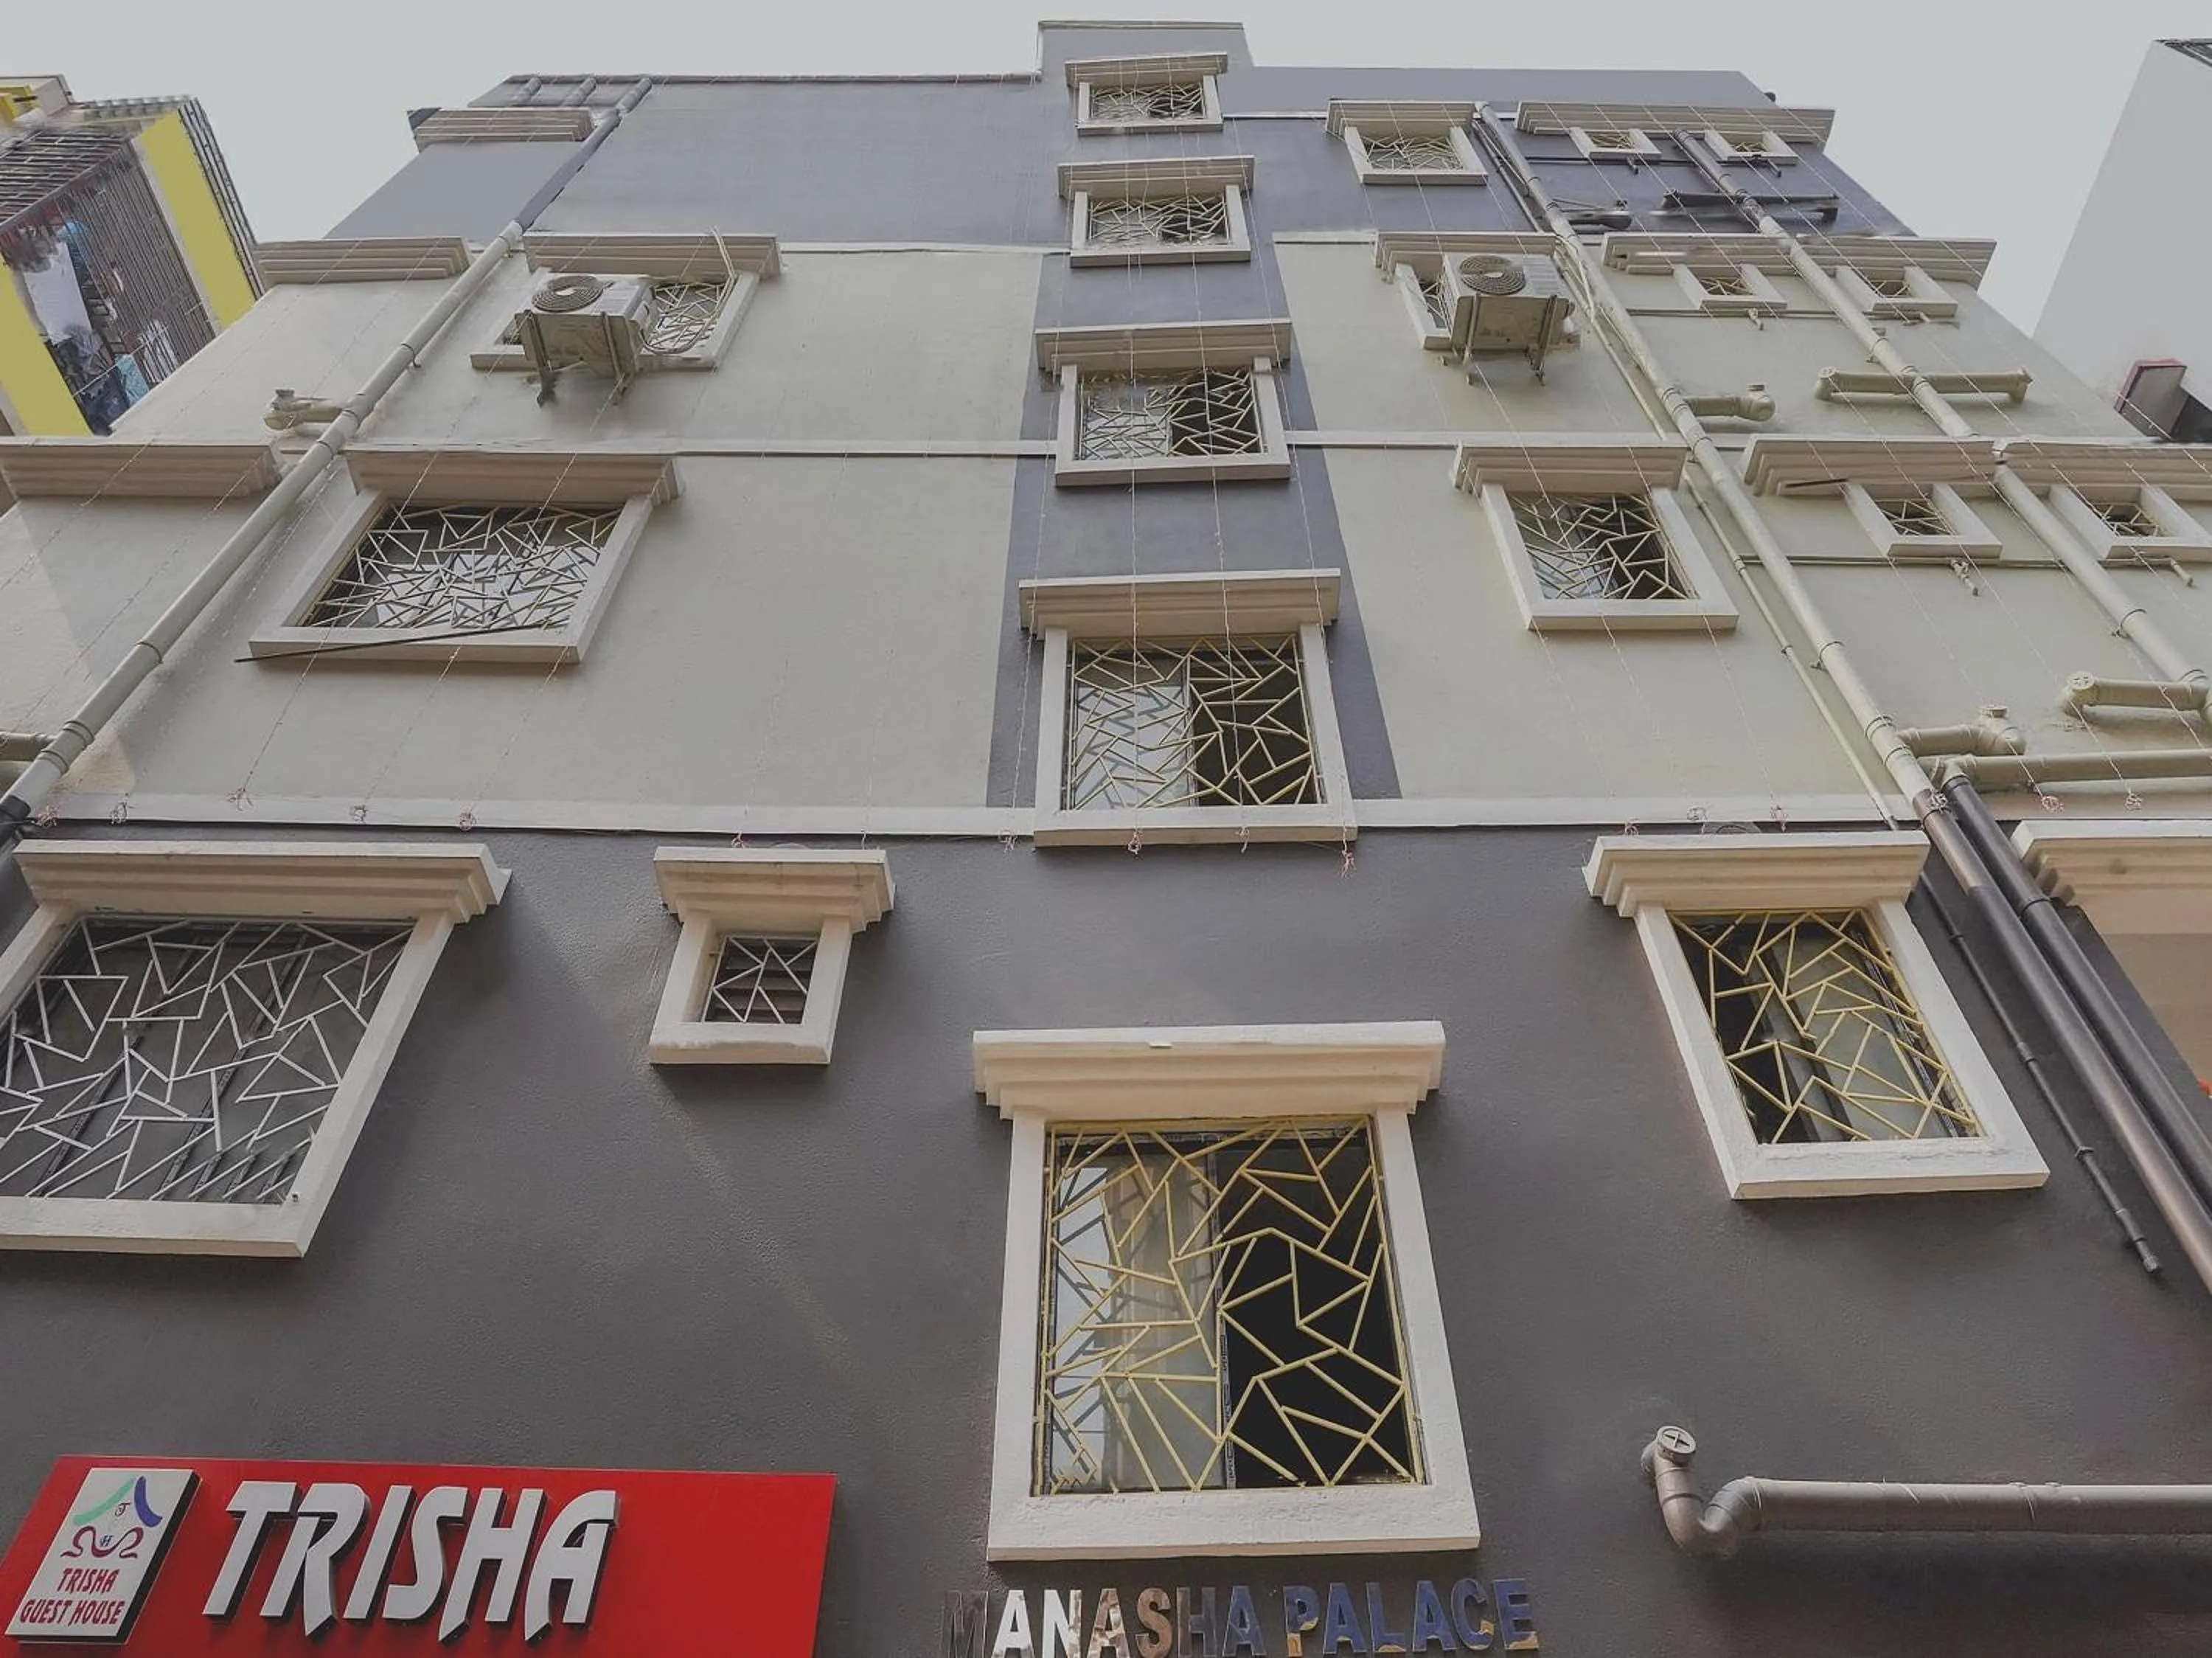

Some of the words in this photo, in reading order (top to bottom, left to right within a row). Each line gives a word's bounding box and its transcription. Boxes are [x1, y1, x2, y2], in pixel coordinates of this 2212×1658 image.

[57, 1568, 119, 1594] TRISHA
[202, 1481, 616, 1641] TRISHA
[20, 1598, 73, 1623] GUEST
[68, 1599, 125, 1626] HOUSE
[942, 1585, 1267, 1658] MANASHA
[1283, 1578, 1540, 1657] PALACE
